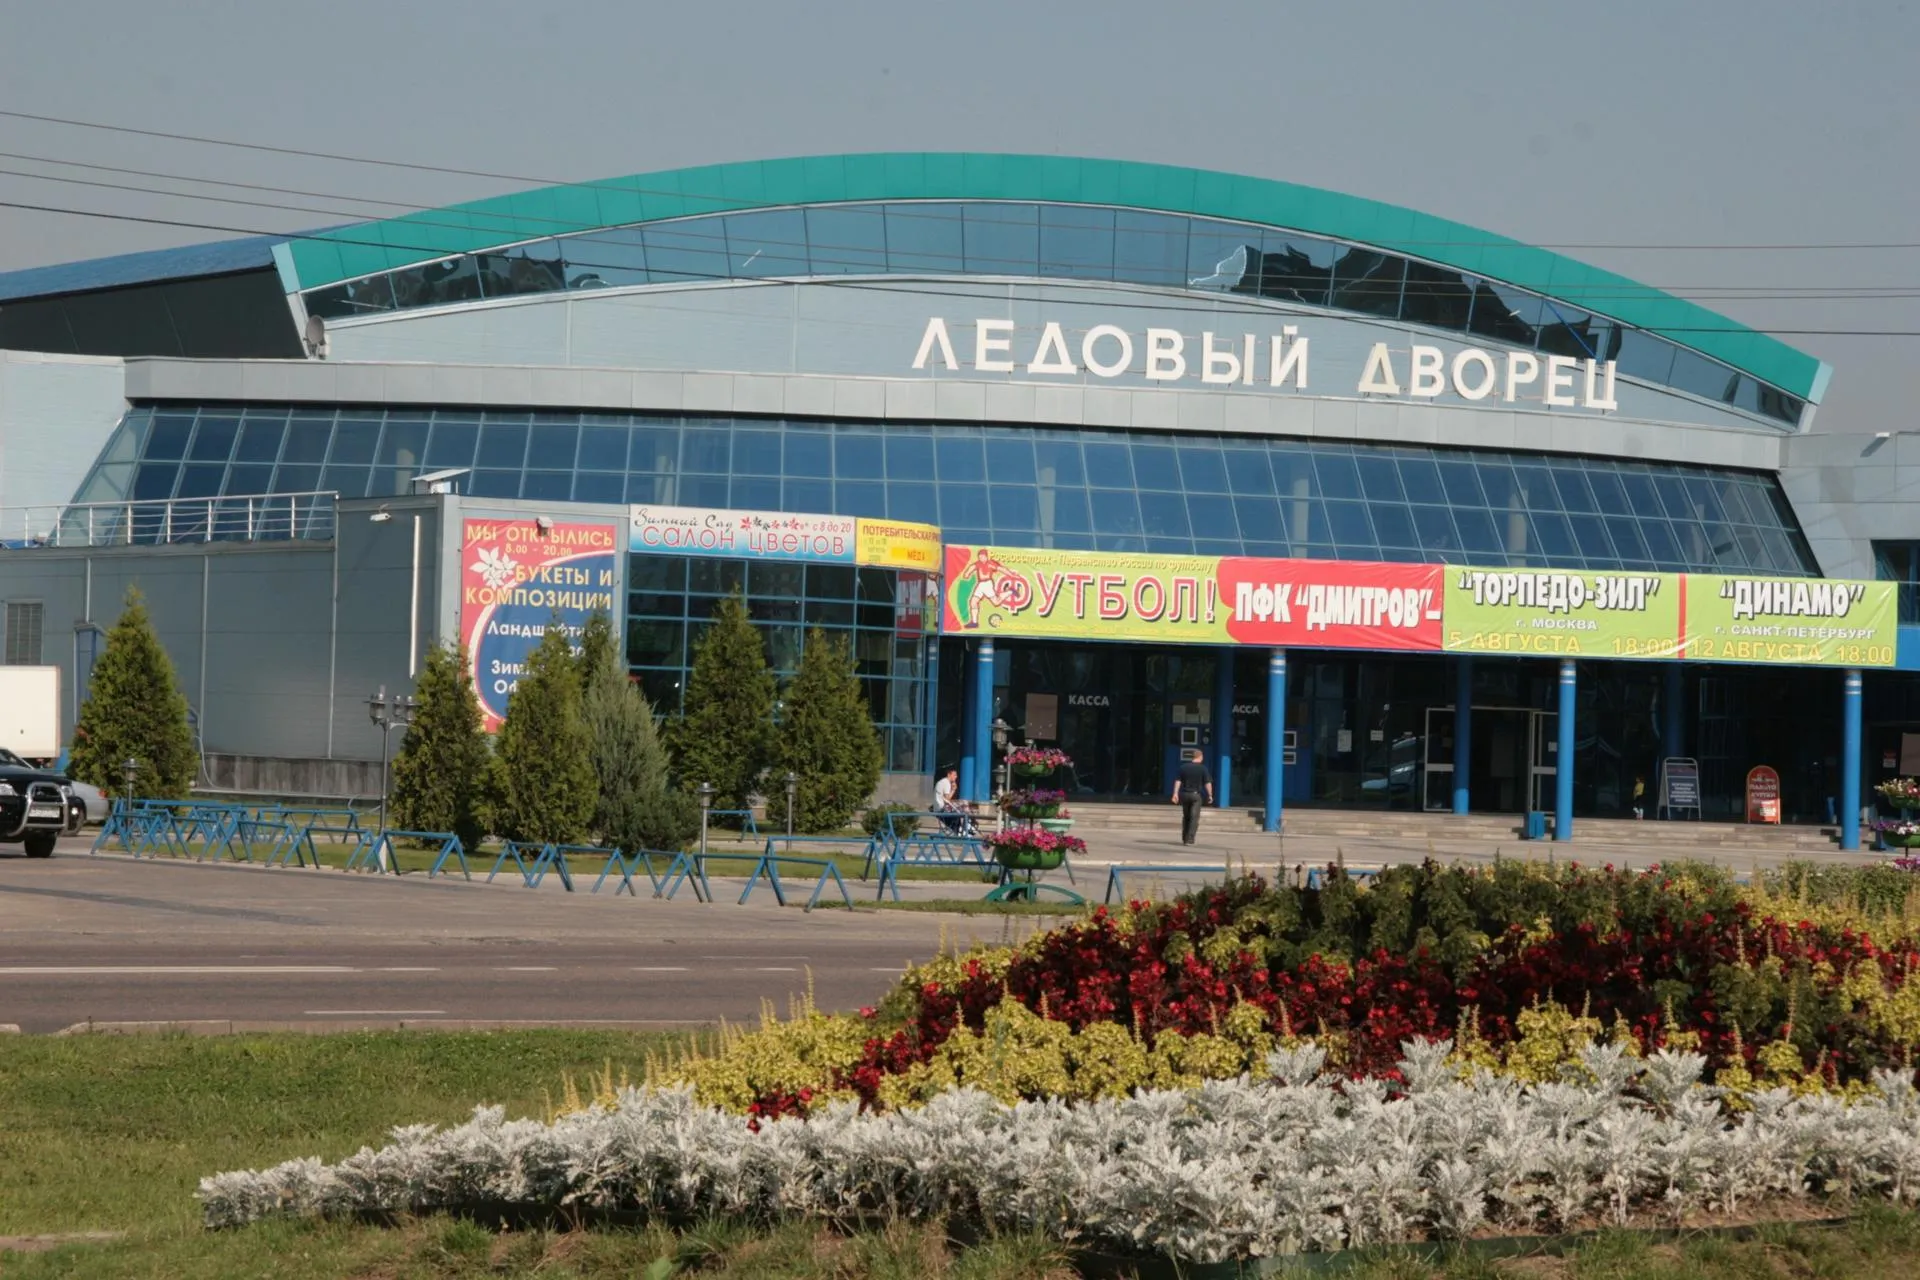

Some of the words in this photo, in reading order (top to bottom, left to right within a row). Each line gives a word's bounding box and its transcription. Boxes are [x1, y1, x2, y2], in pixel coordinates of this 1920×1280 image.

[912, 317, 1309, 388] ЛЕДОВЫЙ
[1358, 342, 1618, 410] ДВОРЕЦ
[634, 508, 698, 527] Зимний
[840, 522, 851, 533] 20
[467, 525, 497, 541] МЫ
[505, 543, 528, 554] 8.00
[543, 545, 572, 556] 20.00
[515, 564, 589, 585] БУКЕТЫ
[600, 569, 612, 587] И
[465, 587, 612, 611] КОМПОЗИЦИИ
[996, 571, 1216, 624] ФУТБОЛ!
[1235, 582, 1292, 622] ПФК
[1458, 572, 1660, 613] "ТОРПЕДО-ЗИЛ"
[1719, 580, 1866, 620] "ДИНАМО"
[1516, 618, 1527, 629] г.
[1532, 618, 1598, 630] МОСКВА
[1714, 625, 1725, 635] г.
[1731, 625, 1878, 640] САНКТ-ПЕТЕРБУРГ
[1471, 632, 1581, 653] АВГУСТА
[1612, 637, 1674, 656] 18:00
[1692, 640, 1714, 658] 12
[1722, 641, 1824, 661] АВГУСТА
[1837, 646, 1893, 664] 18:00
[1068, 695, 1110, 707] КАССА
